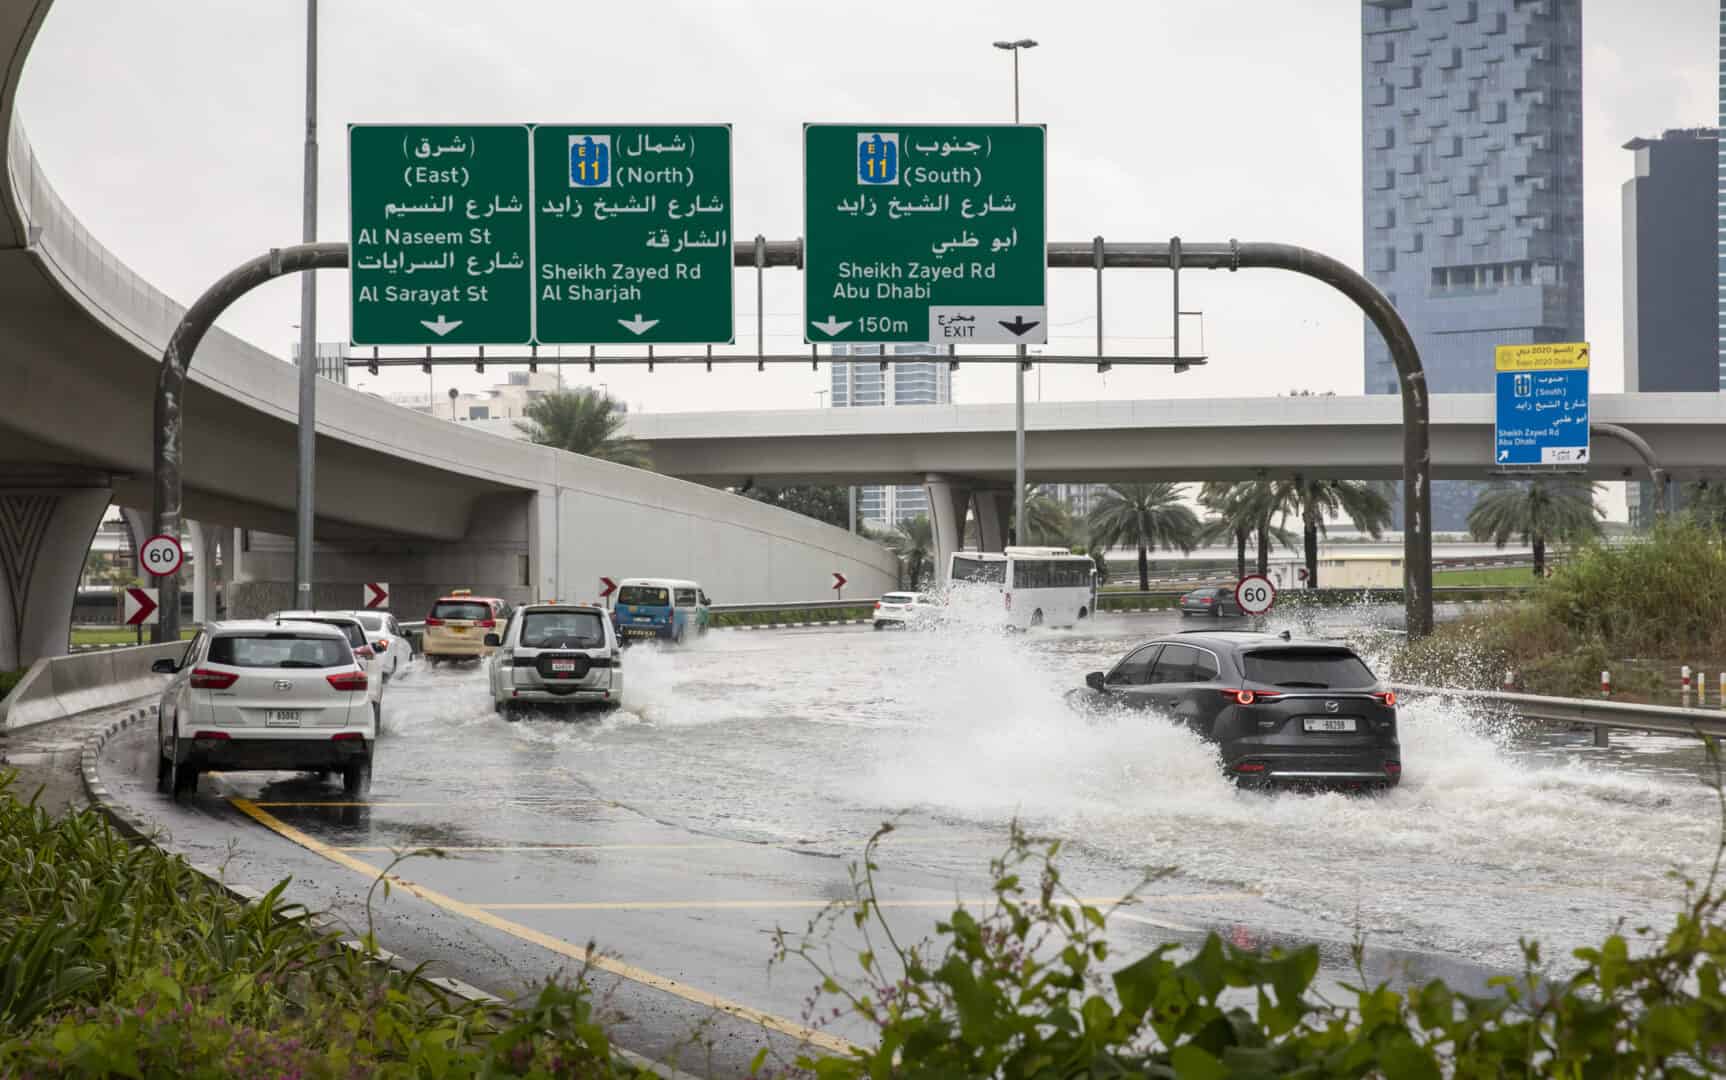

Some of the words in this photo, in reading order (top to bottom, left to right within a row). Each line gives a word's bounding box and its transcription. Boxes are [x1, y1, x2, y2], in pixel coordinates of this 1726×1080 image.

[405, 167, 469, 187] (East)
[578, 161, 598, 180] 11
[617, 168, 693, 186] (North)
[867, 159, 886, 177] 11
[904, 167, 981, 187] (South)
[385, 196, 453, 218] النسيم
[466, 195, 522, 219] شارع
[542, 195, 582, 217] زايد
[594, 195, 656, 220] الشيخ
[668, 195, 723, 219] شارع
[837, 194, 876, 216] زايد
[889, 194, 948, 218] الشيخ
[961, 195, 1016, 218] شارع
[359, 229, 378, 244] Al
[386, 229, 462, 244] Naseem
[470, 228, 491, 244] St
[646, 230, 726, 252] الشارقة
[932, 231, 979, 258] ظبي
[358, 252, 454, 273] السرايات
[467, 252, 523, 275] شارع
[543, 264, 605, 279] Sheikh
[612, 264, 668, 282] Zayed
[677, 264, 700, 279] Rd
[839, 262, 902, 279] Sheikh
[909, 263, 963, 284] Zayed
[971, 263, 995, 278] Rd
[360, 286, 378, 301] Al
[386, 286, 460, 305] Sarayat
[467, 286, 488, 301] St
[543, 285, 561, 300] Al
[569, 285, 640, 303] Sharjah
[833, 283, 869, 298] Abu
[877, 283, 930, 298] Dhabi
[859, 317, 908, 332] 150m
[938, 315, 975, 328] مخرج
[944, 326, 976, 338] EXIT
[150, 548, 174, 563] 60
[1245, 588, 1266, 602] 60
